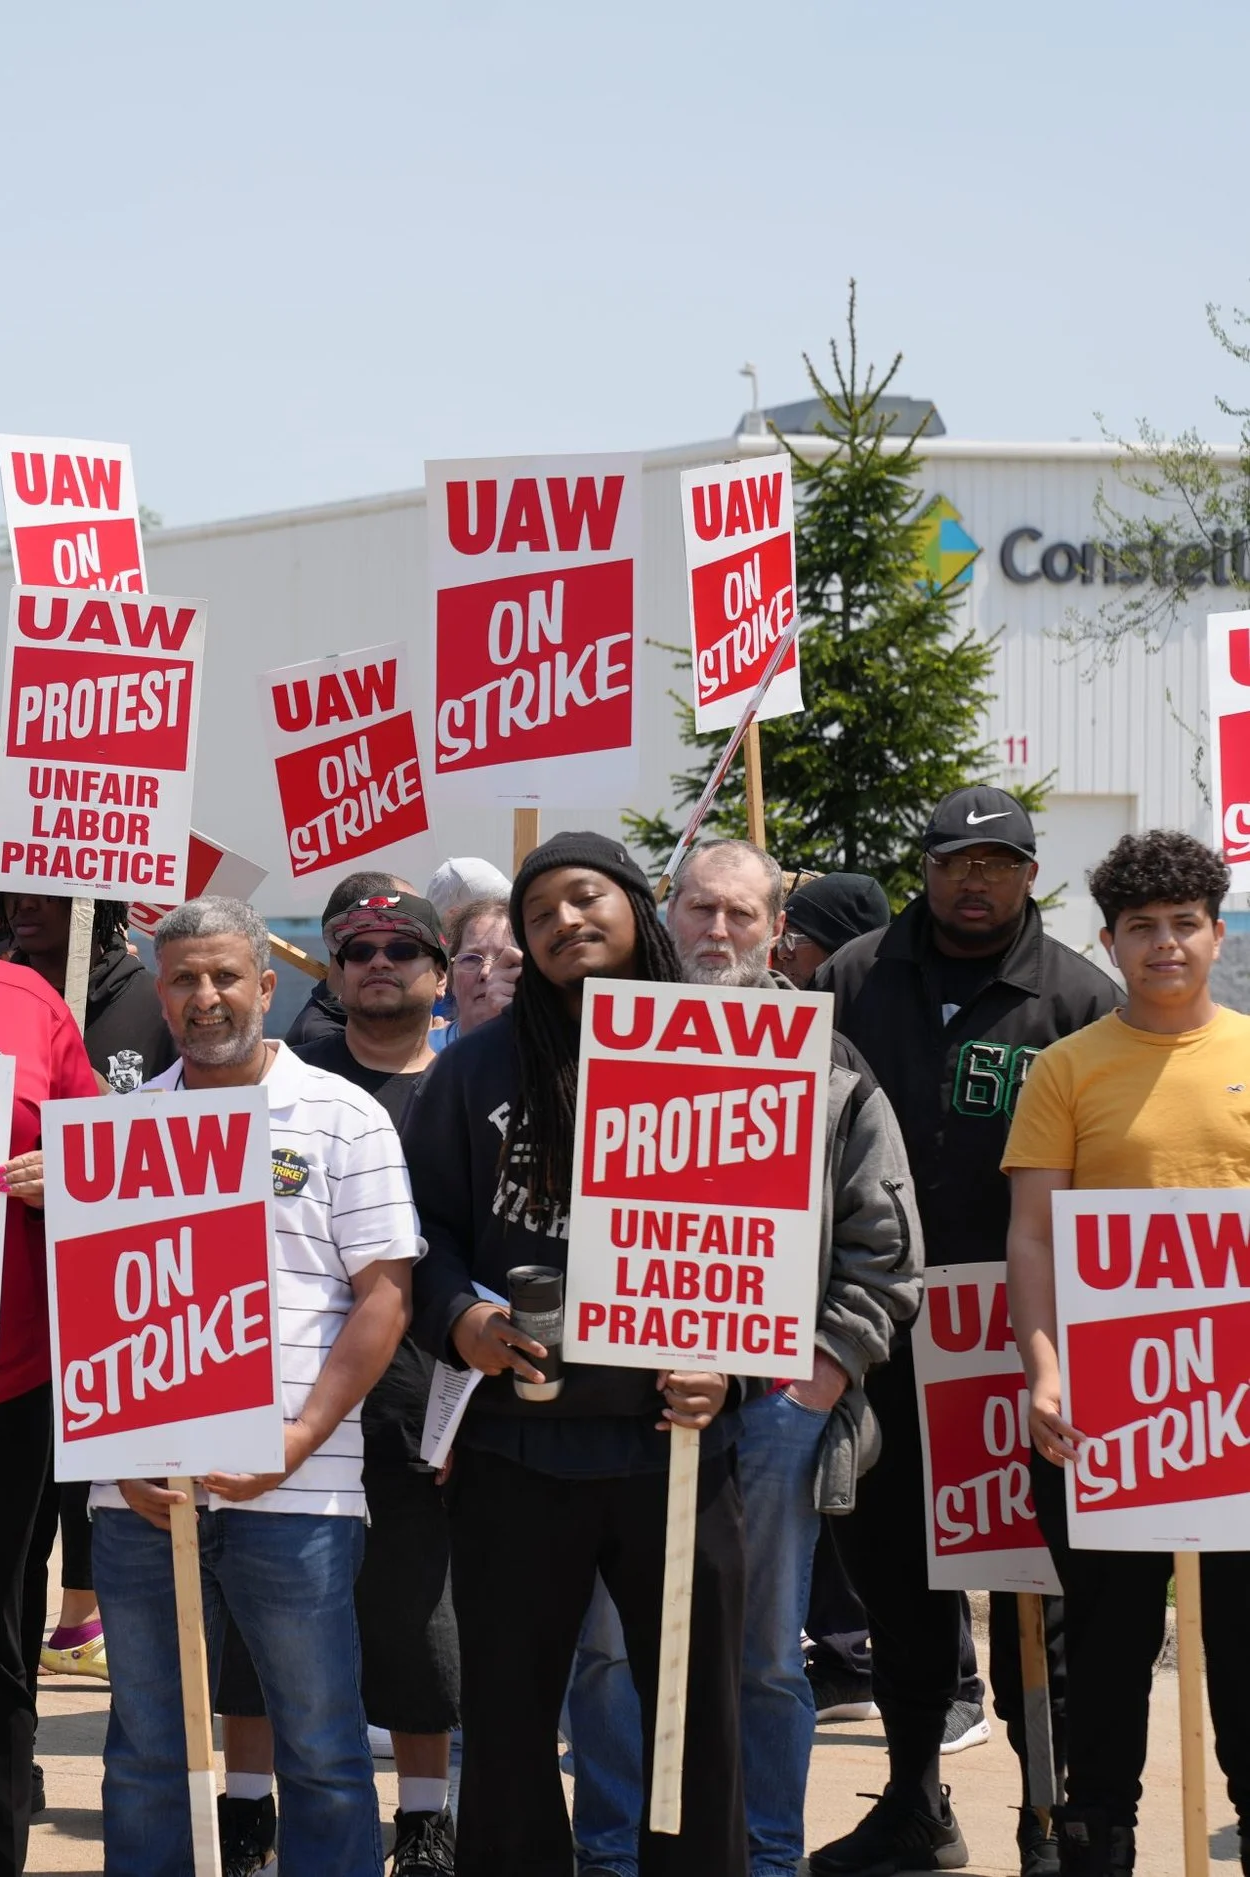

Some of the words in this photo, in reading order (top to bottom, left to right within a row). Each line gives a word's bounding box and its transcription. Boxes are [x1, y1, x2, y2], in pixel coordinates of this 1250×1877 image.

[11, 452, 121, 511] UAW
[446, 475, 624, 555] UAW
[692, 472, 782, 542] UAW
[52, 527, 100, 586] ON
[723, 552, 762, 621] ON
[17, 596, 195, 651] UAW
[487, 580, 564, 666] ON
[698, 584, 792, 699] STRIKE
[16, 668, 186, 746] PROTEST
[271, 659, 397, 732] UAW
[436, 632, 631, 764] STRIKE
[317, 736, 372, 799] ON
[1004, 736, 1028, 765] 11
[29, 766, 159, 808] UNFAIR
[289, 758, 421, 871] STRIKE
[32, 805, 150, 846] LABOR
[1, 842, 176, 887] PRACTICE
[591, 994, 818, 1060] UAW
[63, 1112, 251, 1203] UAW
[592, 1081, 807, 1183] PROTEST
[272, 1164, 303, 1181] TRIKE!
[610, 1208, 775, 1258] UNFAIR
[114, 1226, 193, 1322] ON
[615, 1258, 764, 1306] LABOR
[64, 1280, 268, 1432] STRIKE
[577, 1302, 799, 1356] PRACTICE
[1129, 1316, 1214, 1403] ON
[1077, 1381, 1250, 1503] STRIK
